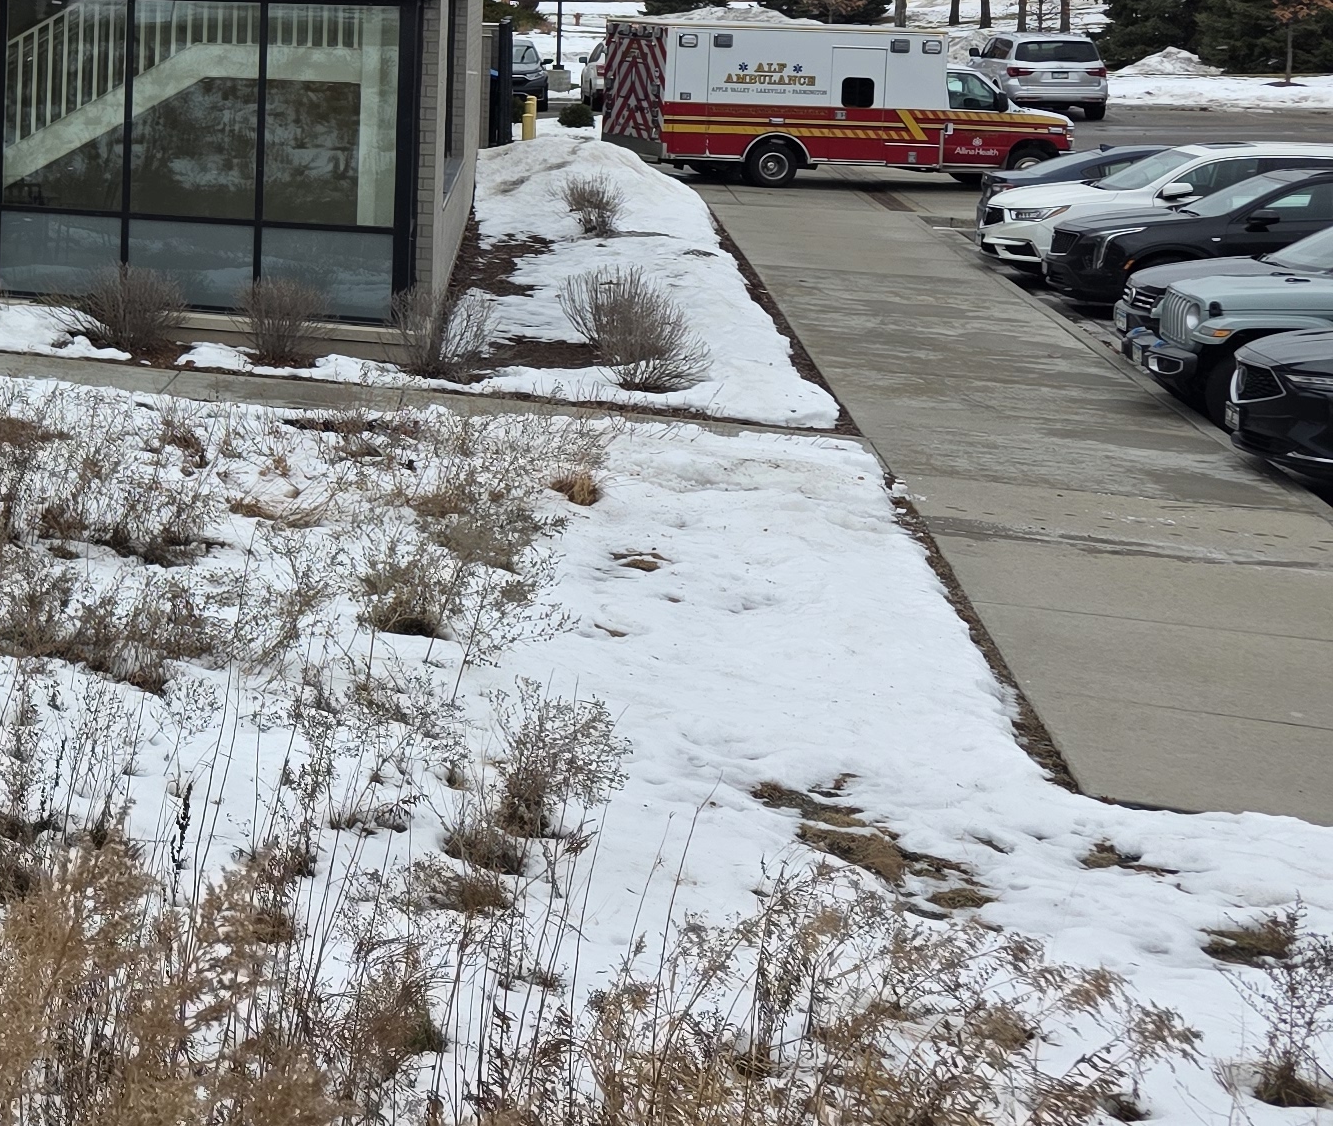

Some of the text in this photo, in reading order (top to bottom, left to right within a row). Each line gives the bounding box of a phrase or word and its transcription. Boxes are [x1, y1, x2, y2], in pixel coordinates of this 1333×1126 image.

[754, 62, 787, 73] ALF
[724, 73, 816, 86] AMBULANCE
[954, 146, 999, 156] Allina Health
